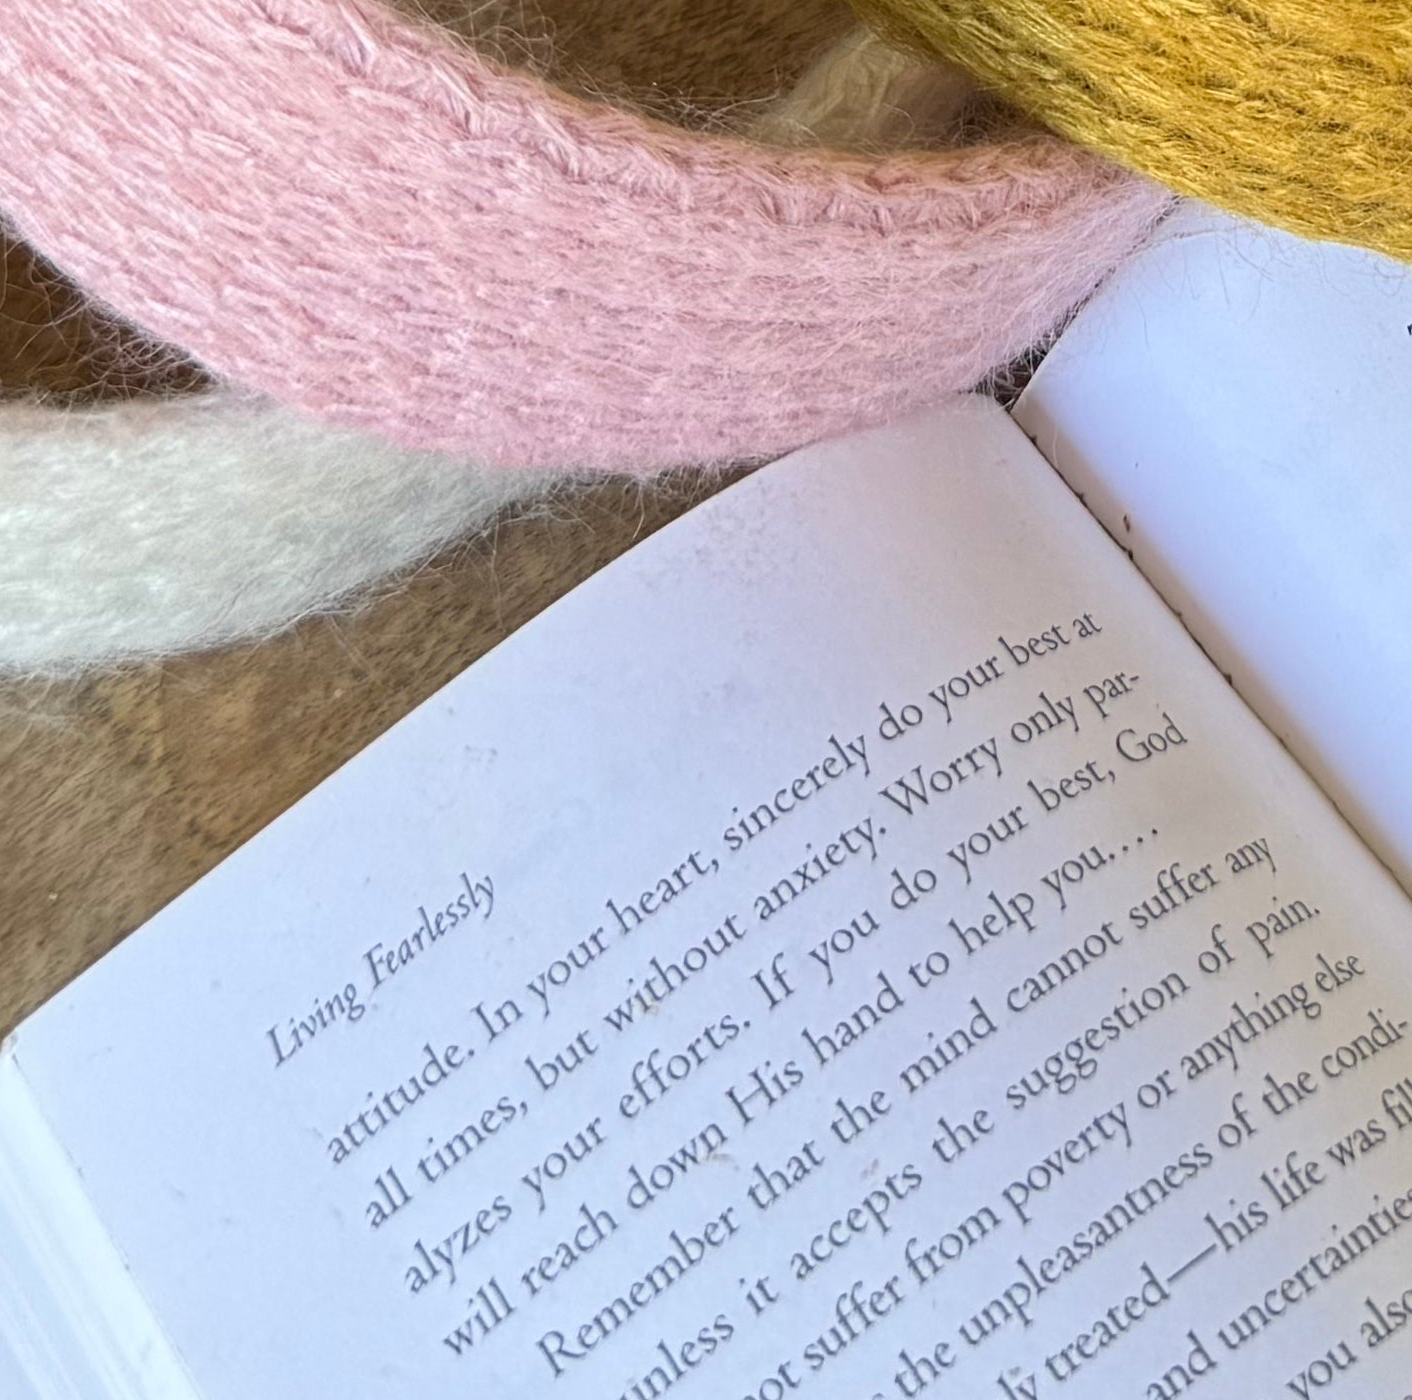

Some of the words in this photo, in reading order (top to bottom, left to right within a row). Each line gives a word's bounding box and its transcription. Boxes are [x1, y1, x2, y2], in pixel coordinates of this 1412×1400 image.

[266, 983, 366, 1068] Living
[362, 871, 494, 989] Fearlessly
[327, 1042, 476, 1165] attitude.
[470, 999, 524, 1044] In
[526, 926, 609, 1019] your
[605, 850, 720, 936] heart,
[723, 733, 872, 852] sincerely
[878, 700, 924, 742] do
[927, 655, 1005, 725] your
[997, 624, 1072, 668] best
[1071, 612, 1103, 639] at
[404, 1194, 513, 1294] alyzes
[520, 1116, 605, 1213] your
[618, 1013, 752, 1120] efforts.
[750, 951, 795, 1011] If
[807, 909, 881, 987] you
[890, 867, 938, 911] do
[945, 804, 1029, 887] your
[1026, 760, 1117, 813] best,
[1115, 710, 1189, 763] God
[535, 1206, 740, 1379] Remember
[747, 1139, 825, 1211] that
[830, 1090, 893, 1145] the
[898, 995, 999, 1095] mind
[1006, 921, 1124, 1014] cannot
[1128, 861, 1221, 931] suffer
[1224, 837, 1277, 875] any
[1259, 1149, 1326, 1212] life
[1325, 1118, 1388, 1168] was
